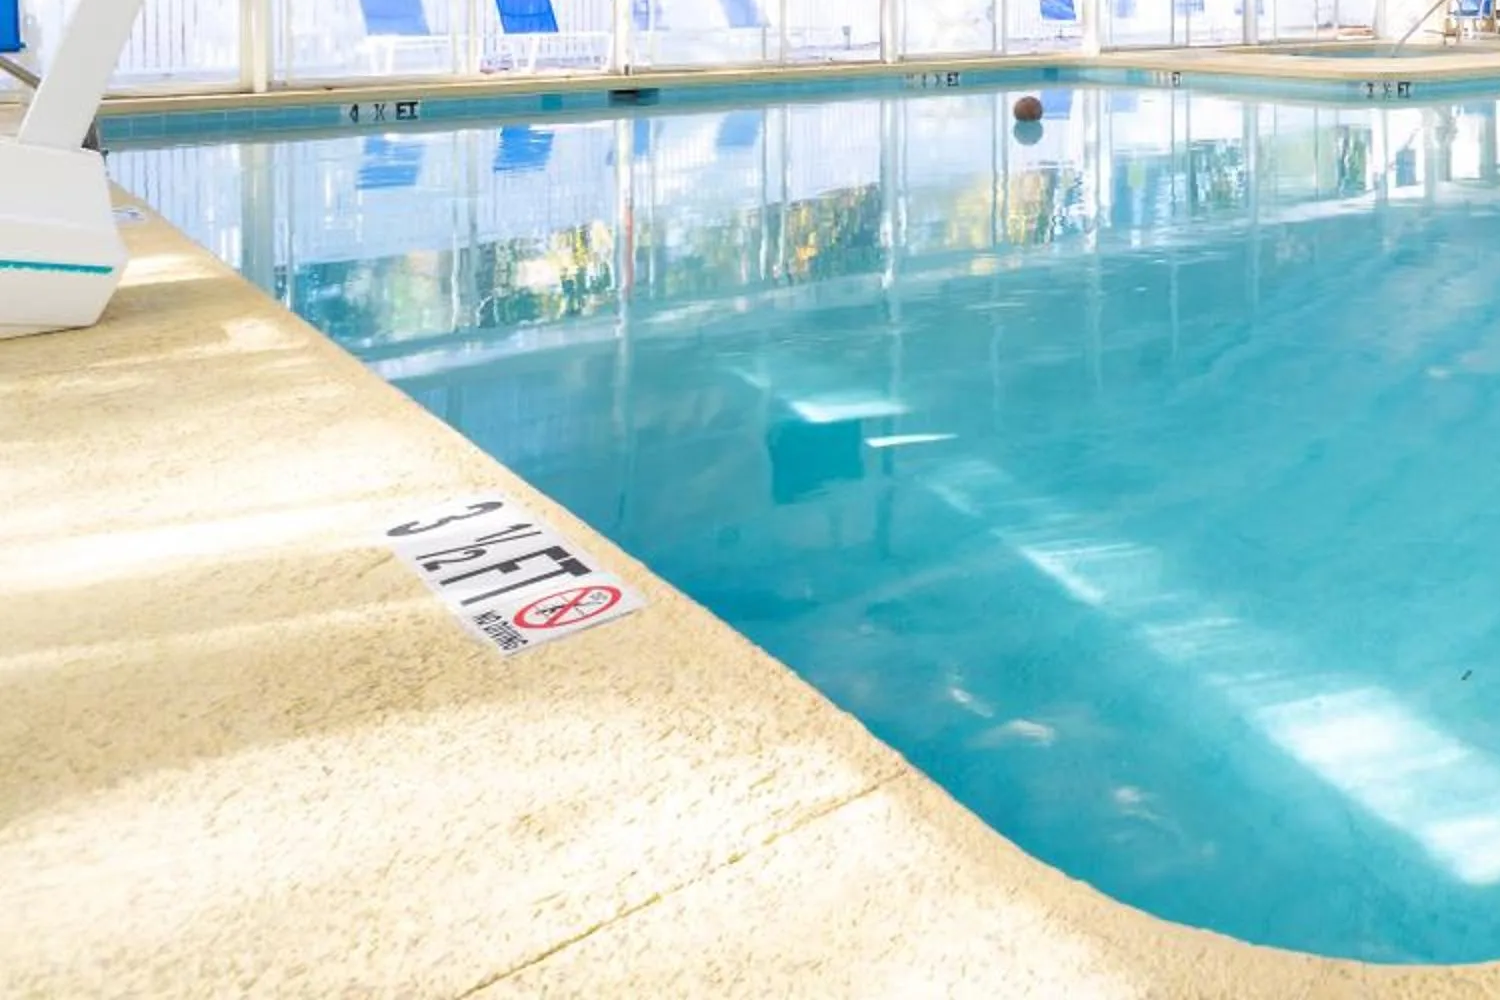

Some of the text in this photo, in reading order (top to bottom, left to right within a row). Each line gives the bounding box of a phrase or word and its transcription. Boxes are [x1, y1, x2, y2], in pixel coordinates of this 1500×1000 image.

[1397, 81, 1411, 98] FT
[395, 101, 419, 120] FT
[386, 501, 504, 537] 3
[439, 545, 593, 606] FT
[473, 610, 529, 651] NO DIVING
